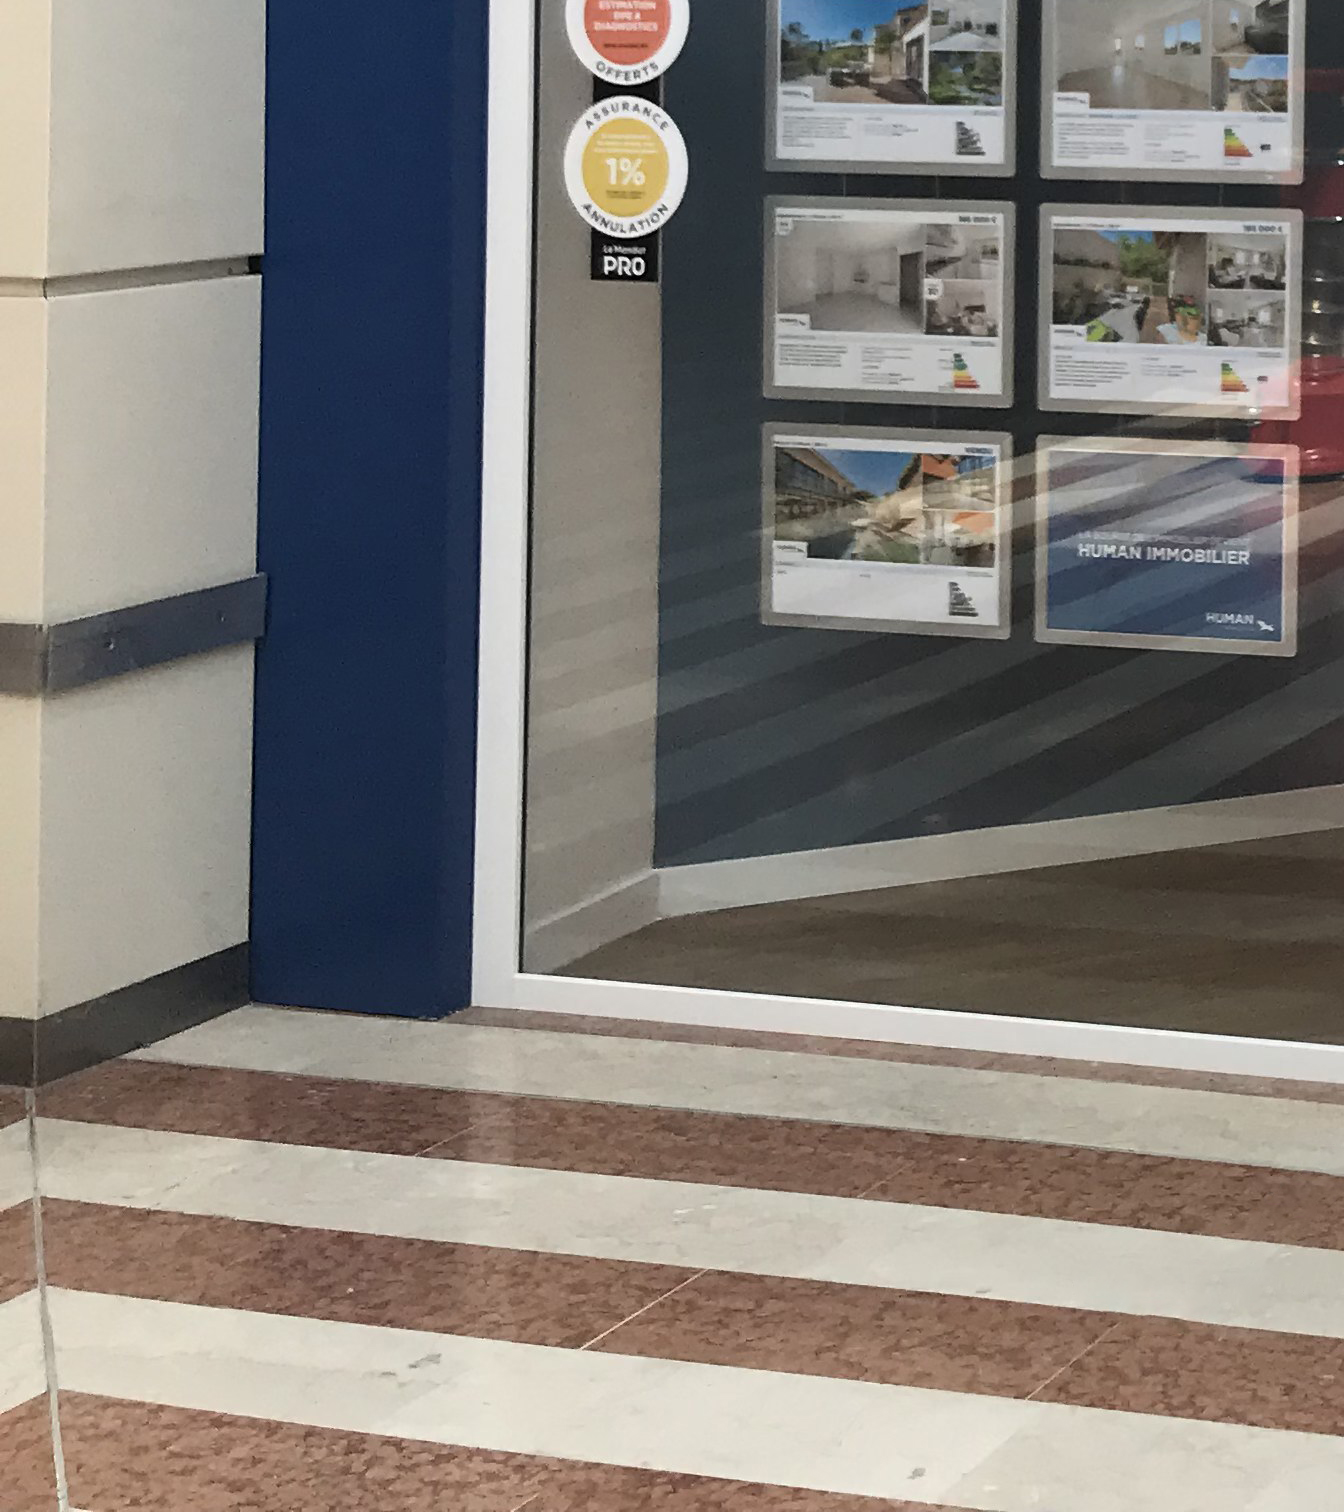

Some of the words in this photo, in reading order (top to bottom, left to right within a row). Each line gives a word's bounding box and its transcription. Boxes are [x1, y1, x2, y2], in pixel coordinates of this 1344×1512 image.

[595, 60, 660, 82] OFFERTS
[585, 101, 670, 132] ASSURANCE
[605, 157, 646, 186] 1%
[581, 202, 670, 234] ANNULATION
[603, 255, 646, 277] PRO
[1077, 543, 1141, 560] HUMAN
[1147, 546, 1250, 565] IMMOBILIER
[1205, 612, 1254, 625] HUMAN
